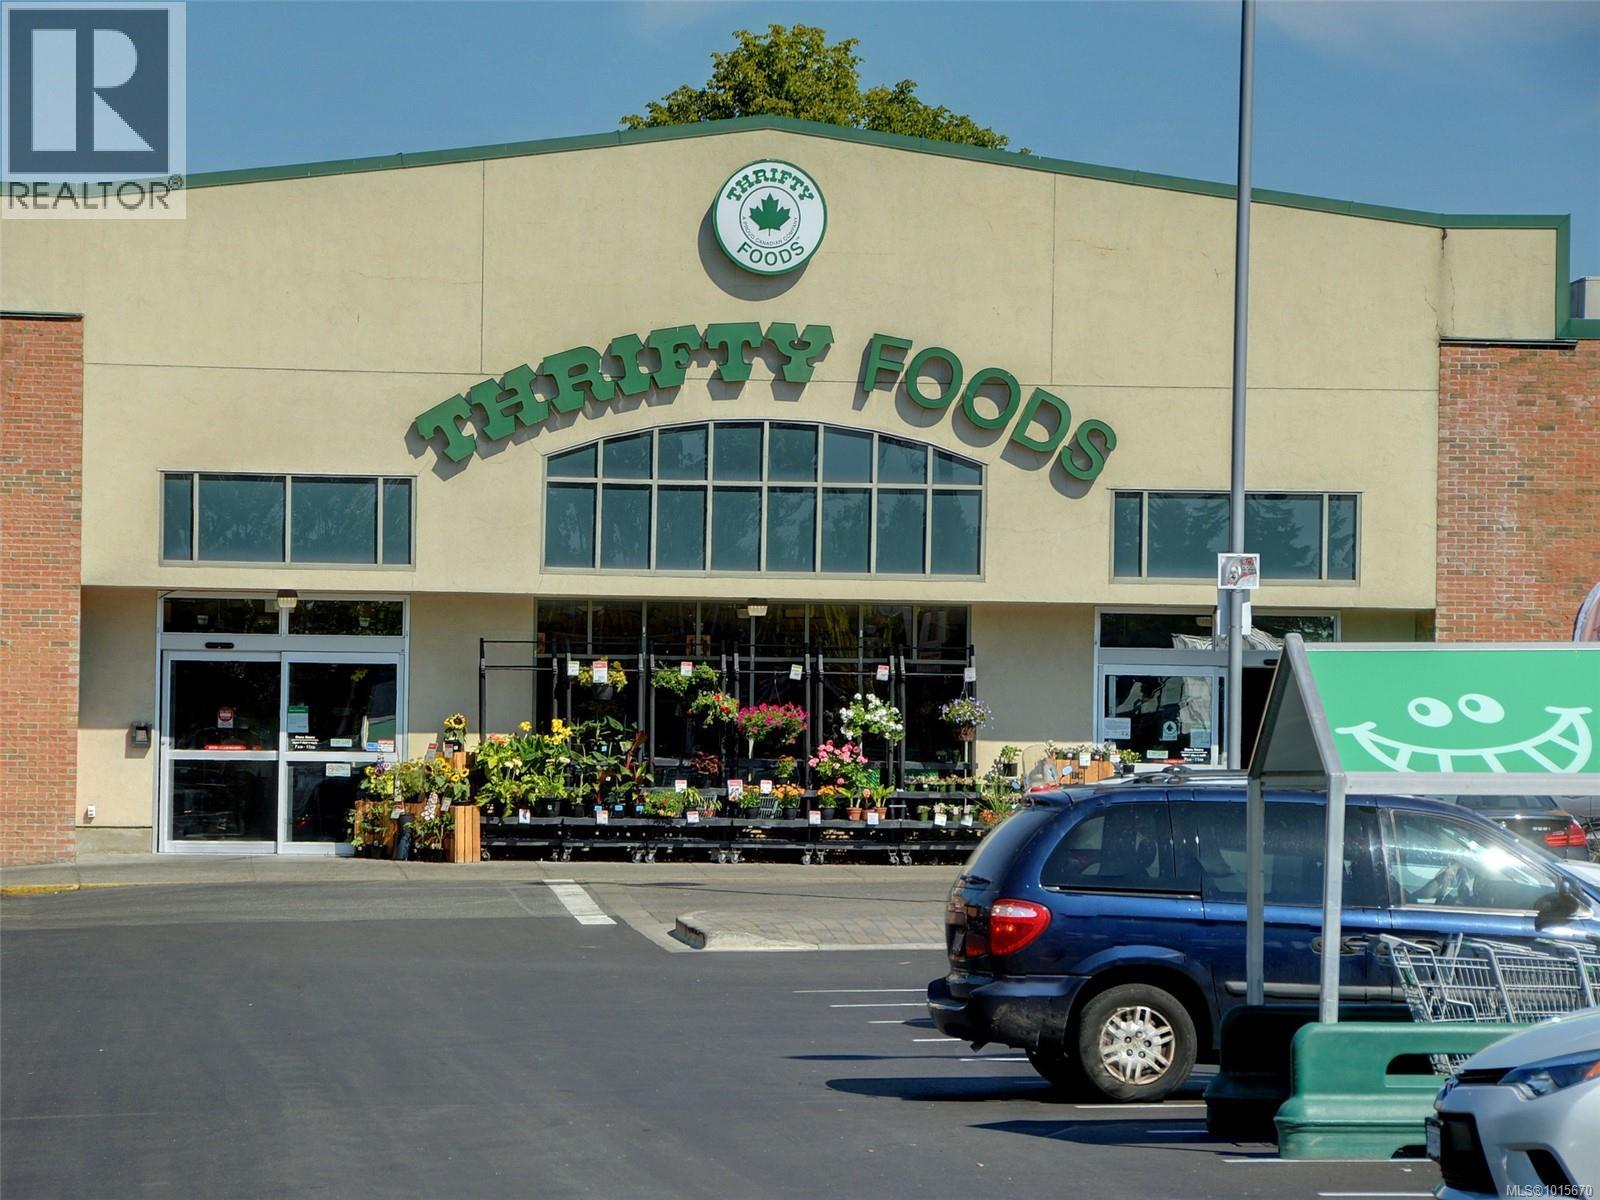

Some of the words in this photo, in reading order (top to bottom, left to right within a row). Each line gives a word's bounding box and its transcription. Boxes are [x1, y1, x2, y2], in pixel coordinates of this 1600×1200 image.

[726, 168, 814, 202] THRIFTY
[737, 241, 805, 266] FOODS
[755, 237, 783, 246] CANADIAN
[415, 322, 834, 462] THRIFTY
[864, 333, 1118, 482] FOODS
